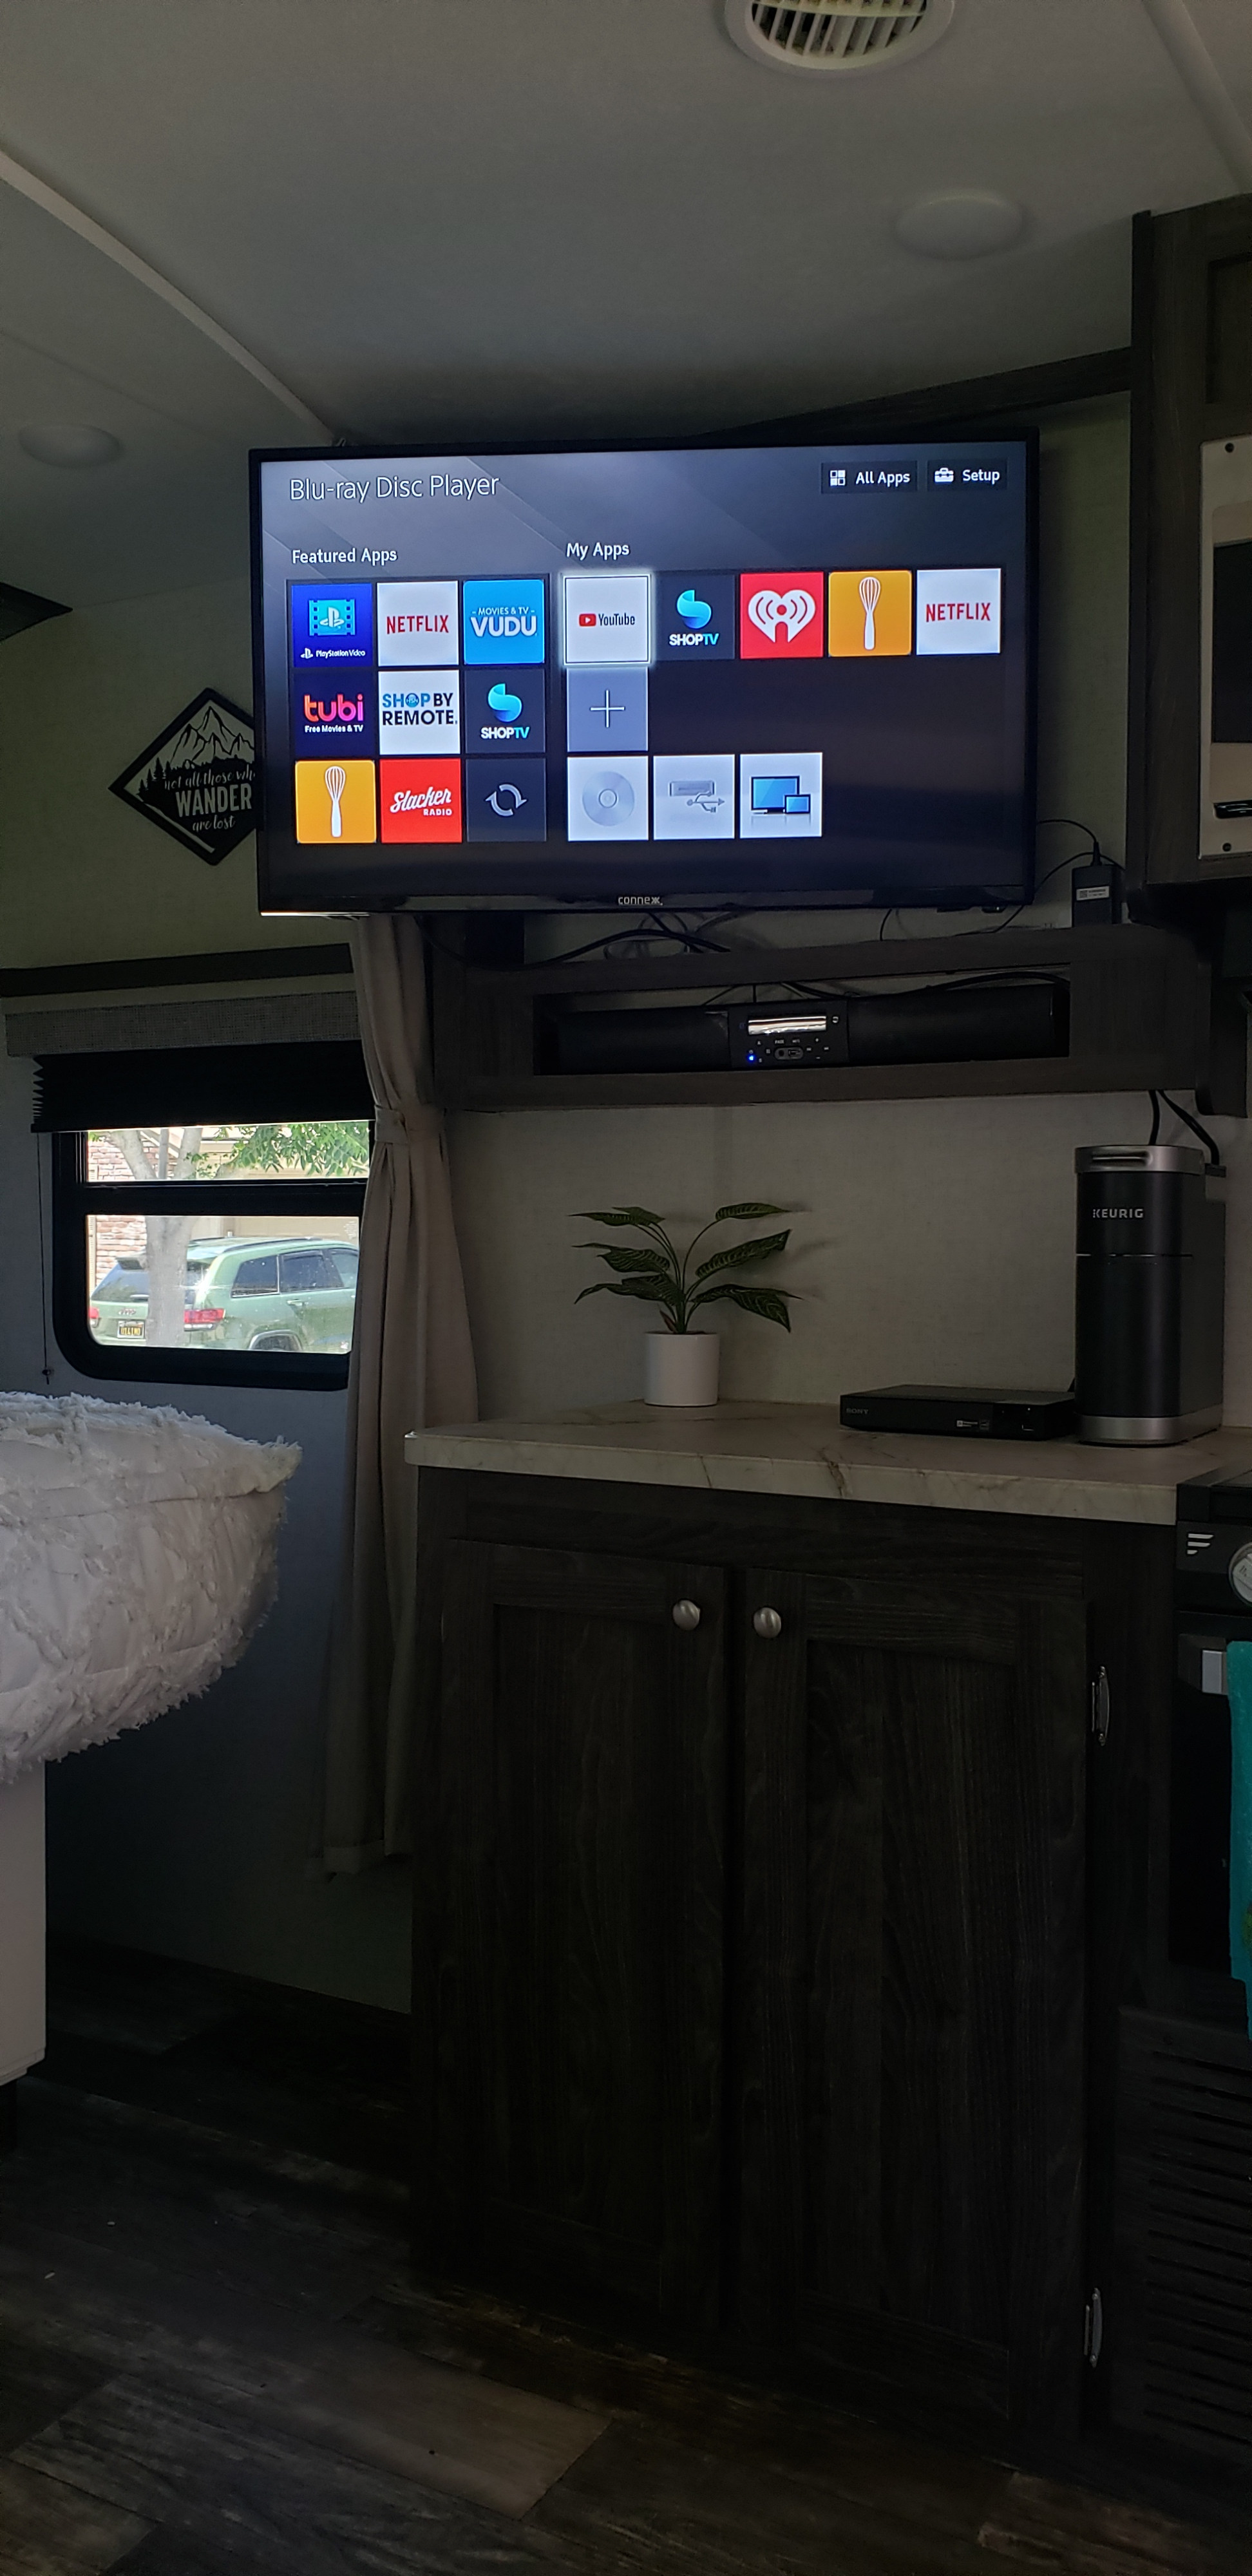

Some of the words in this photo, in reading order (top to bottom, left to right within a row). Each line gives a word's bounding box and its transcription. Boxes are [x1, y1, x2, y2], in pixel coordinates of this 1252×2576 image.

[855, 471, 875, 484] All
[877, 470, 911, 487] Apps
[962, 469, 1000, 484] Setup
[290, 478, 370, 503] Blu-ray
[376, 476, 422, 498] Disc
[430, 474, 500, 500] Player
[292, 548, 356, 564] Featured
[361, 547, 397, 566] Apps
[566, 542, 589, 561] My
[593, 542, 630, 560] Apps
[477, 607, 509, 616] MOVIES
[510, 607, 516, 615] &
[598, 612, 635, 626] YouTube
[925, 602, 991, 623] NETFLIX
[386, 614, 450, 634] NETFLIX
[470, 615, 536, 637] VUDU
[304, 694, 364, 722] tubi
[383, 693, 431, 708] SHOP
[433, 693, 453, 706] BY
[321, 724, 346, 733] Movies
[164, 775, 182, 791] not
[185, 771, 202, 788] all
[204, 768, 233, 786] those
[175, 782, 252, 818] WANDER
[390, 786, 452, 813] Slacker
[423, 808, 452, 816] RADIO
[192, 820, 213, 833] are
[213, 814, 236, 830] lost
[1092, 1208, 1144, 1218] KEURIG
